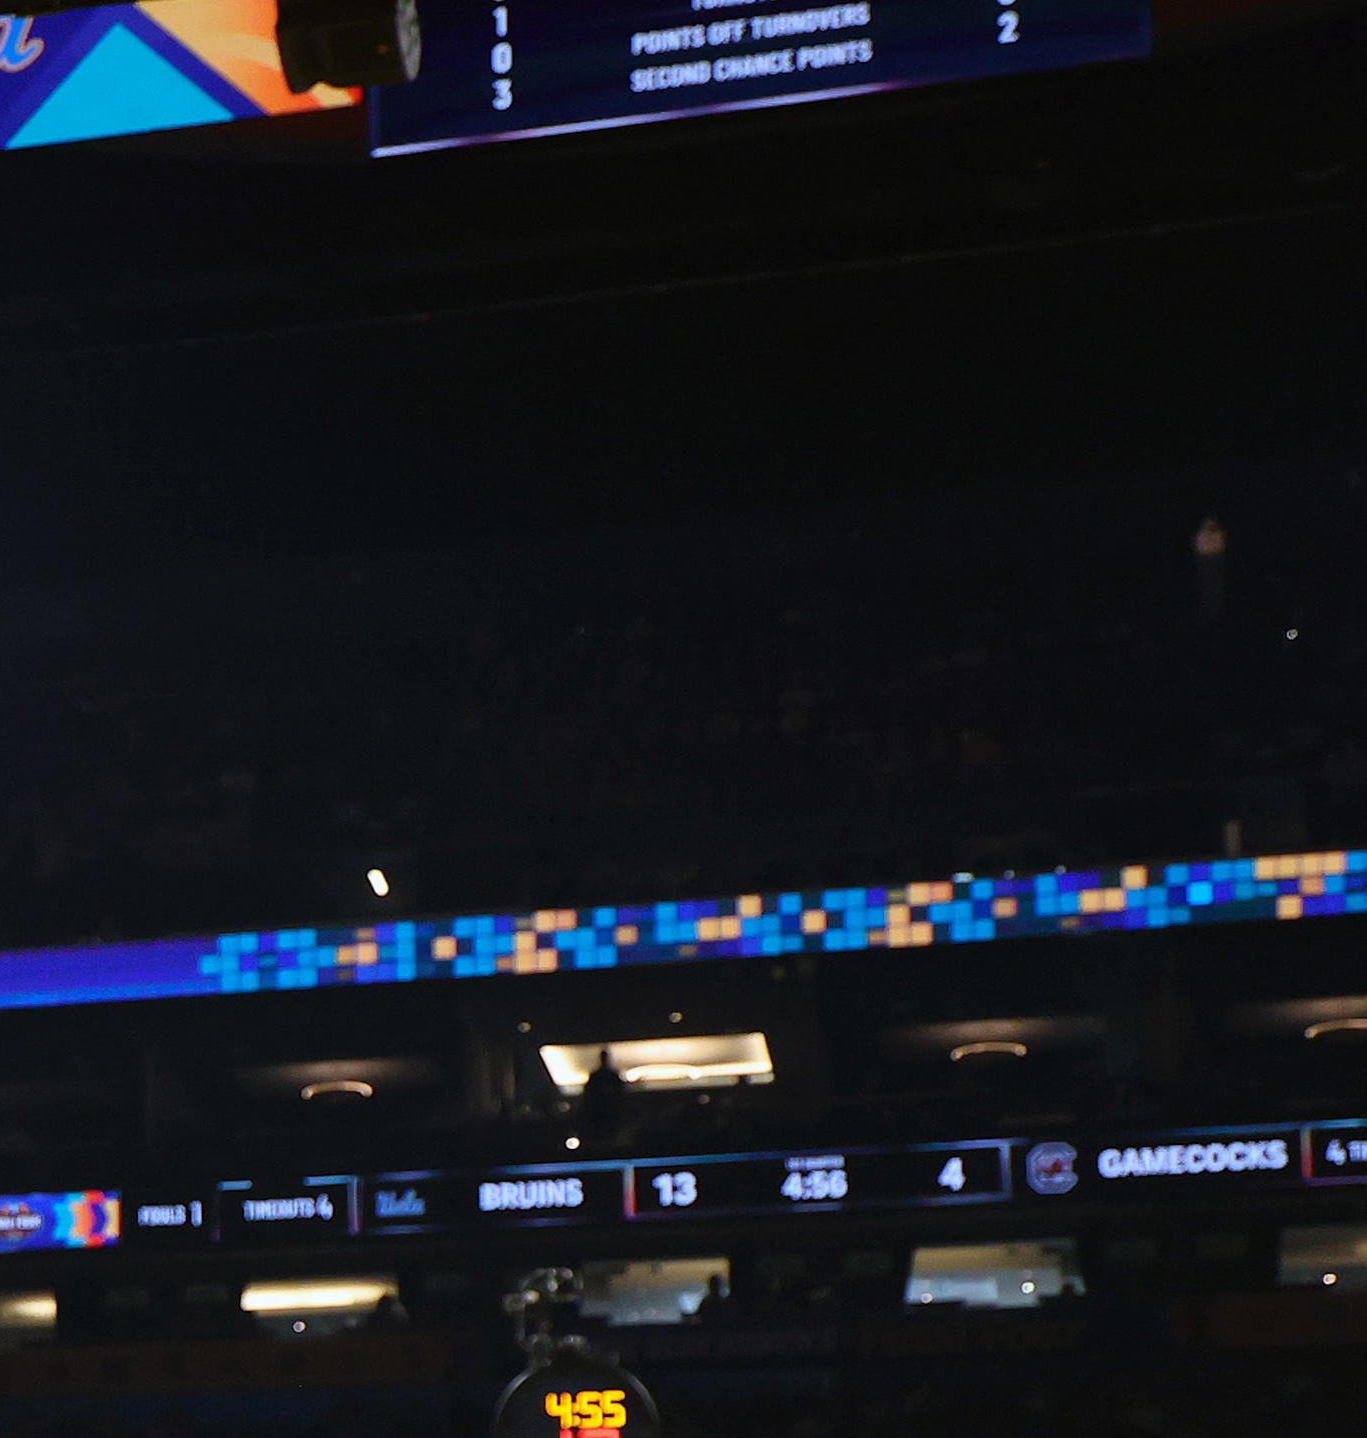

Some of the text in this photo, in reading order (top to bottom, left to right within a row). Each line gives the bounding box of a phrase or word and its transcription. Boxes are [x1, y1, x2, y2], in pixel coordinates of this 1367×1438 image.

[492, 5, 508, 37] 1
[631, 1, 871, 56] POINTS OFF TURNOVERS
[997, 10, 1020, 44] 2
[490, 42, 513, 74] 0
[630, 38, 873, 92] SECOND CHANCE POINTS
[492, 78, 513, 110] 3
[1097, 1139, 1289, 1179] GAMECOCKS
[1325, 1139, 1347, 1166] 4
[652, 1171, 698, 1207] 13
[938, 1157, 965, 1192] 4
[478, 1178, 585, 1211] BRUINS
[545, 1390, 627, 1429] 4:55
